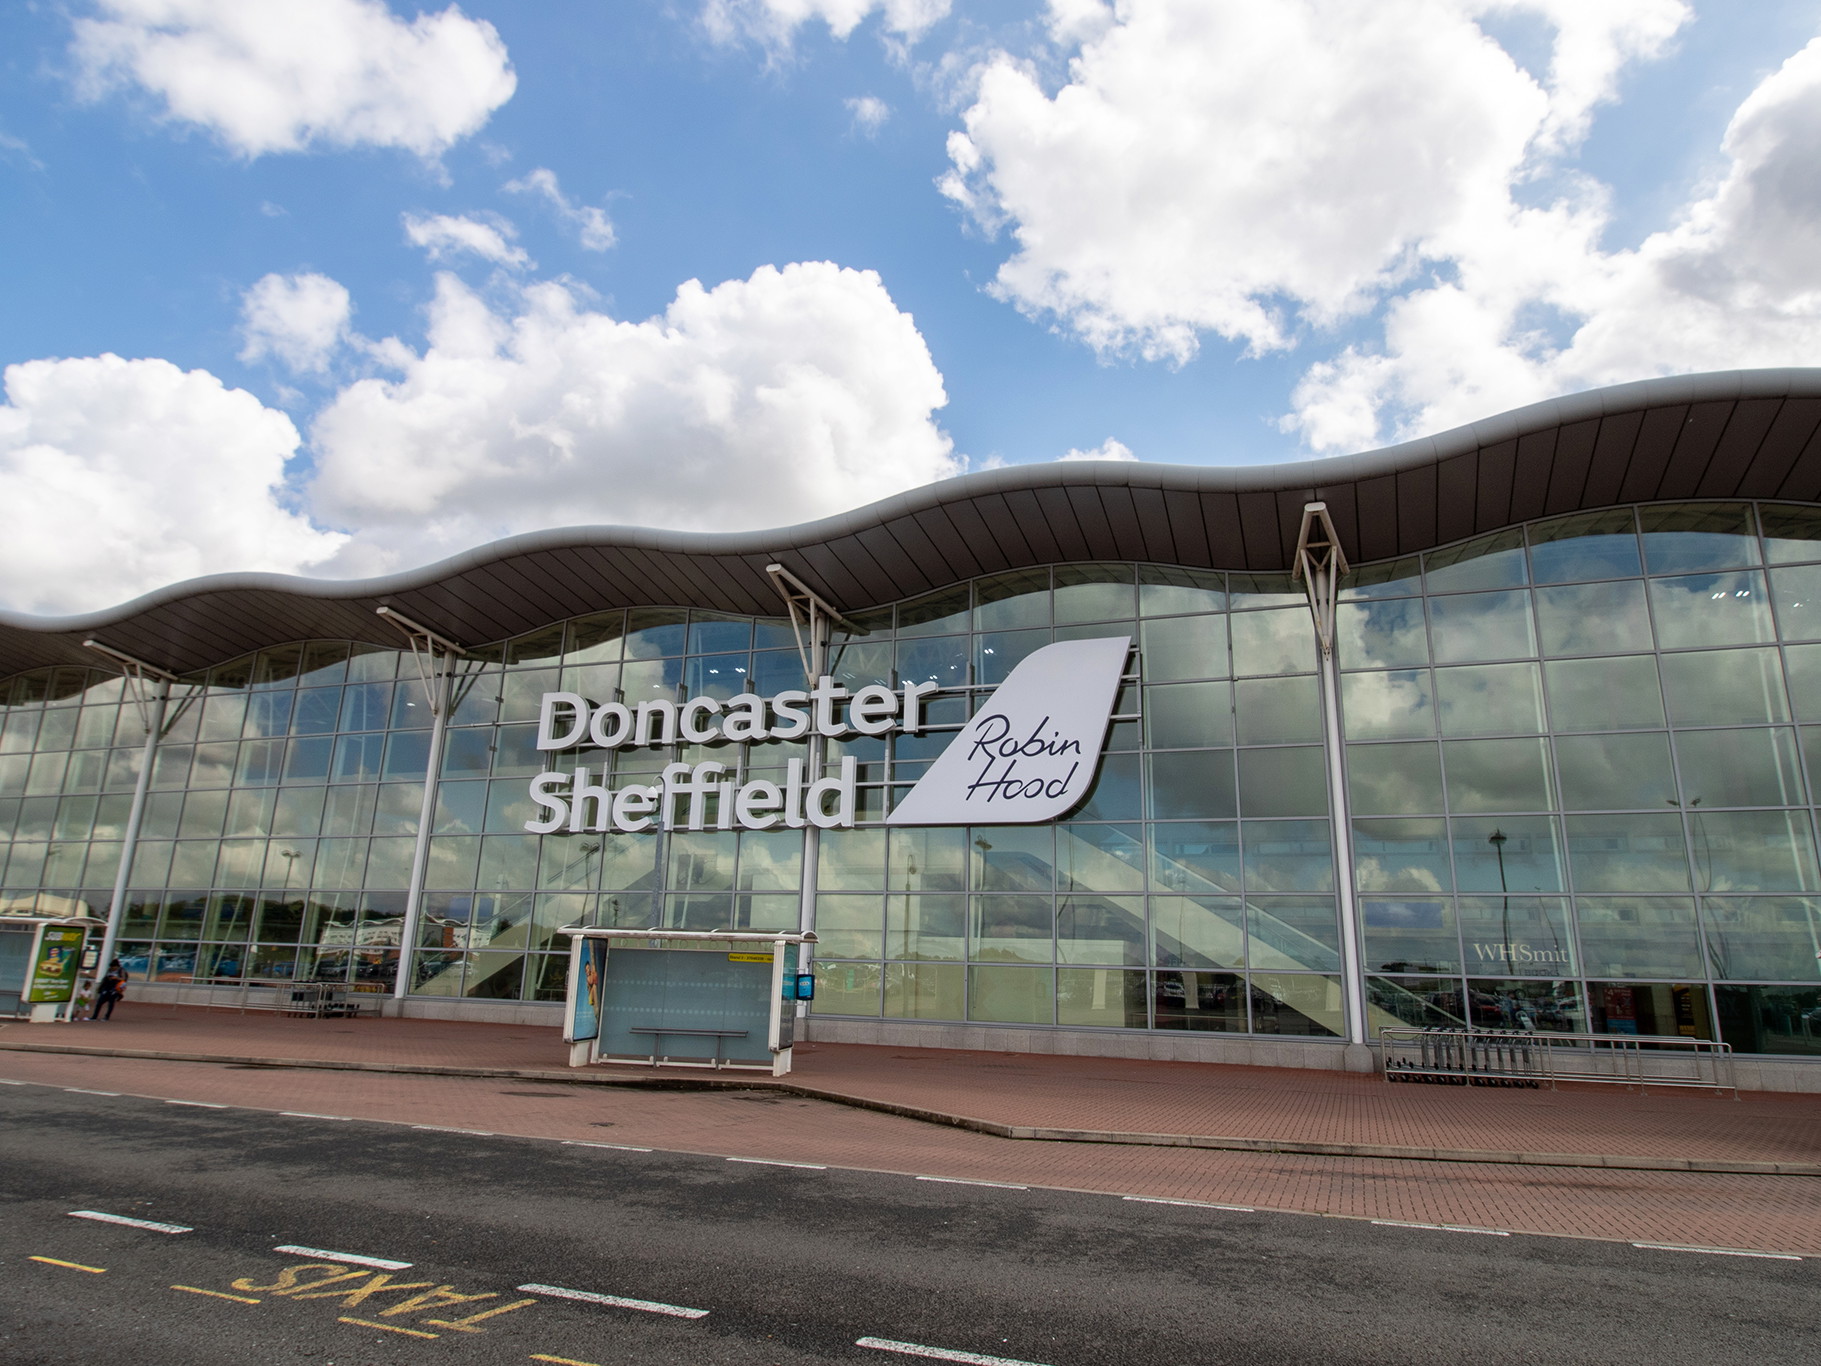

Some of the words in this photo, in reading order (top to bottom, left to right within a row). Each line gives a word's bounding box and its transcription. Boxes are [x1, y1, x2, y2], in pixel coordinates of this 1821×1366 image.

[537, 675, 939, 750] Doncaster
[968, 713, 1082, 760] Robin
[525, 755, 857, 834] Sheffield
[966, 758, 1079, 803] Hood
[1473, 943, 1569, 962] WHSmit
[231, 1264, 539, 1332] TAXIS
